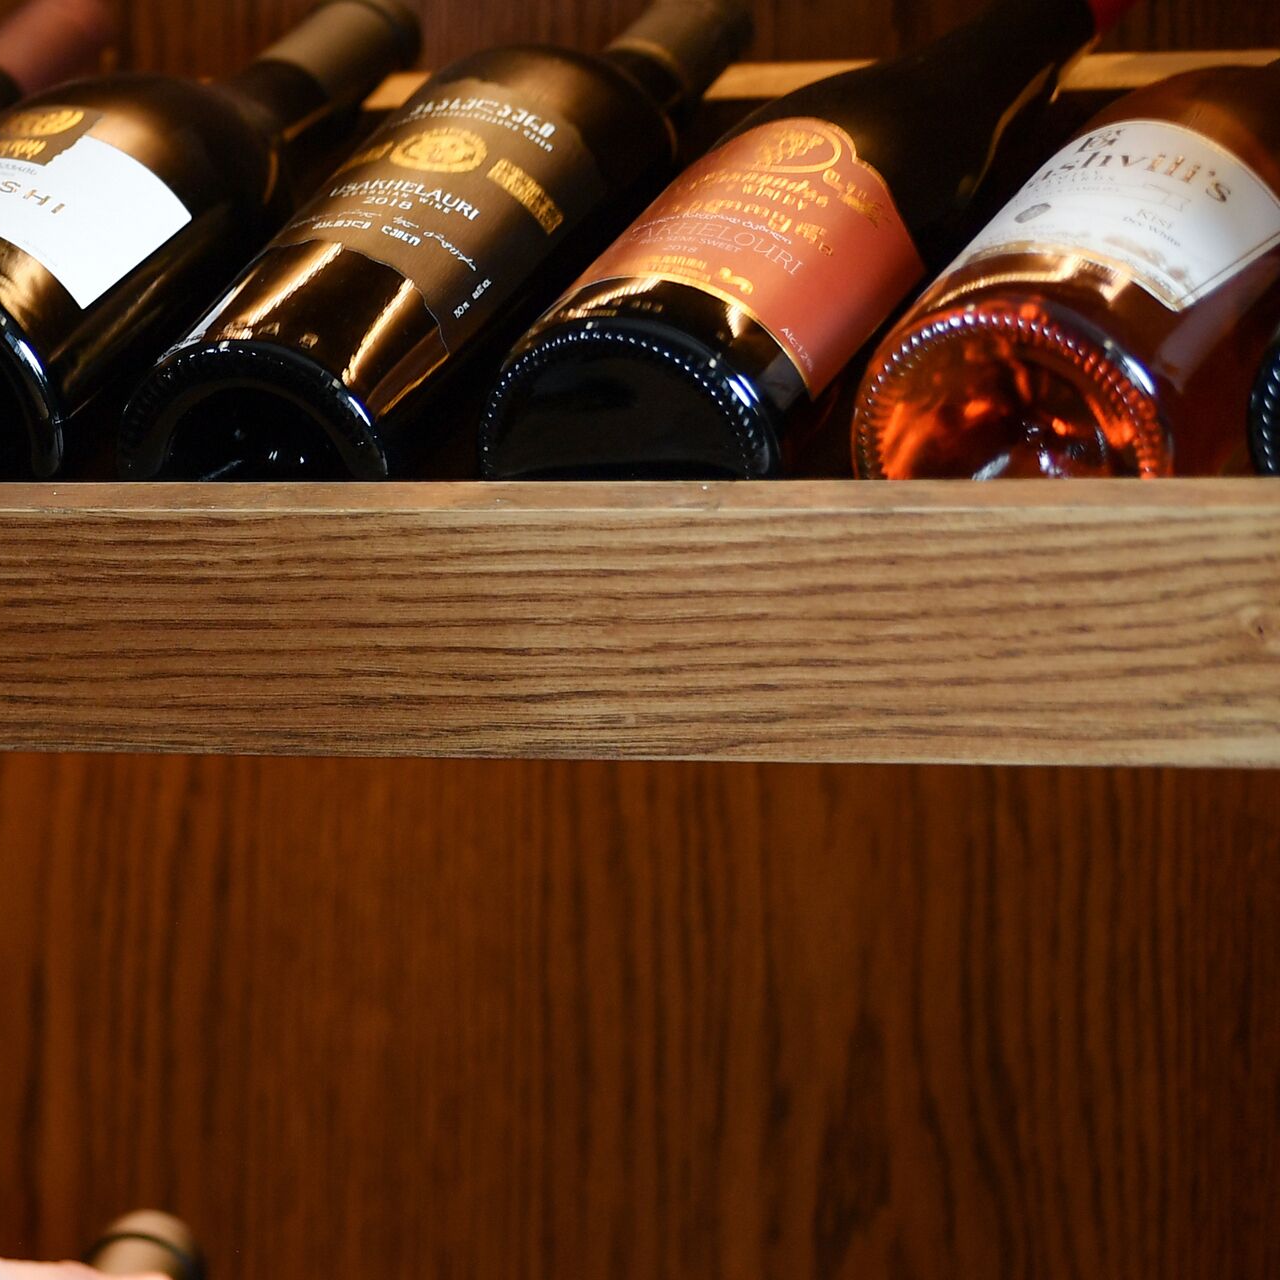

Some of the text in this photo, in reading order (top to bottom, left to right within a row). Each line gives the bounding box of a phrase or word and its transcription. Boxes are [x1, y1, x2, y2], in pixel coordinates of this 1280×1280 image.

[329, 178, 481, 221] USAKHELAURI
[362, 196, 413, 210] 2018
[418, 197, 451, 215] WINE
